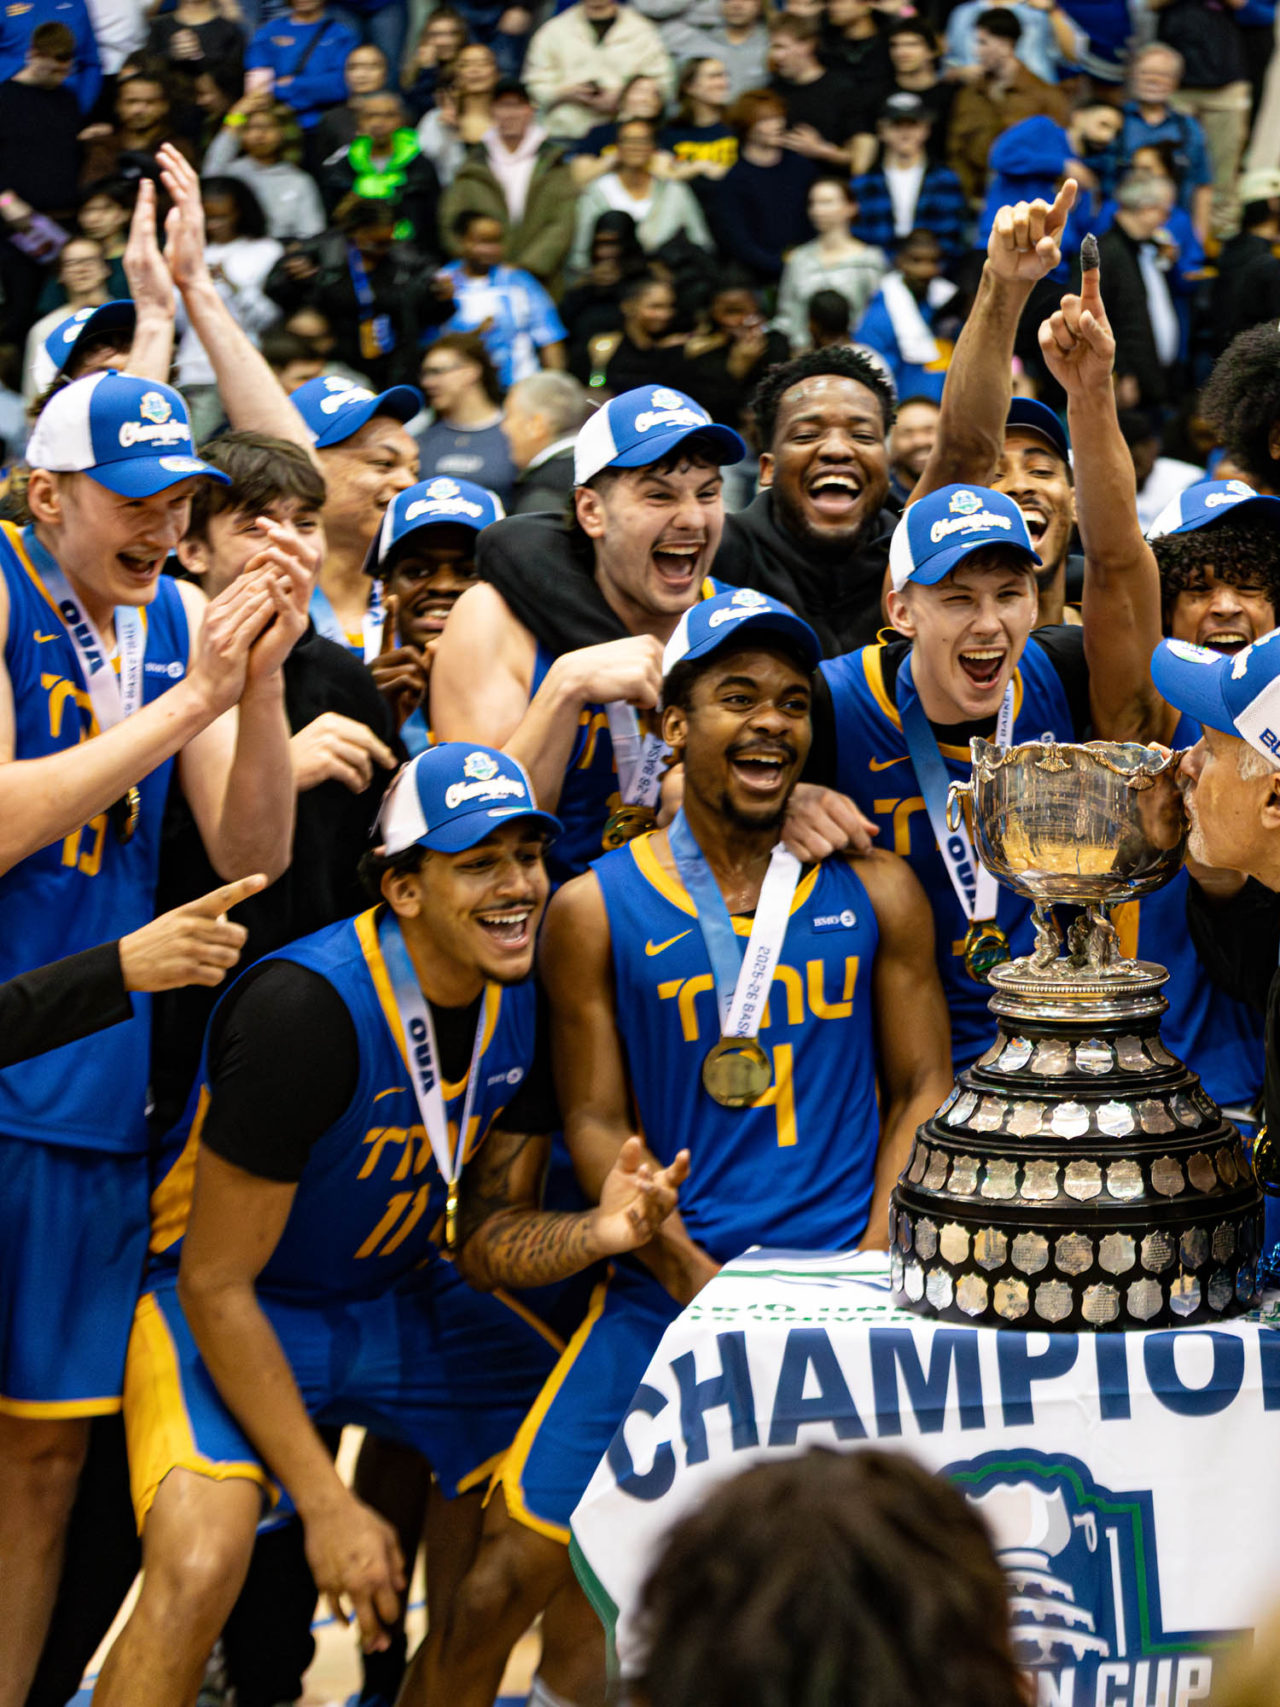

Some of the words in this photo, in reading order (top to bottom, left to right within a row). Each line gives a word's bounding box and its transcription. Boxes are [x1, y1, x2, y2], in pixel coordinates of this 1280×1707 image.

[930, 510, 1012, 543] Champions
[59, 599, 105, 677] OUA
[813, 915, 840, 927] BMO
[746, 945, 771, 1001] 2025-26
[407, 1017, 438, 1097] OUA
[353, 1182, 431, 1259] 11
[1095, 1656, 1213, 1707] CUP
